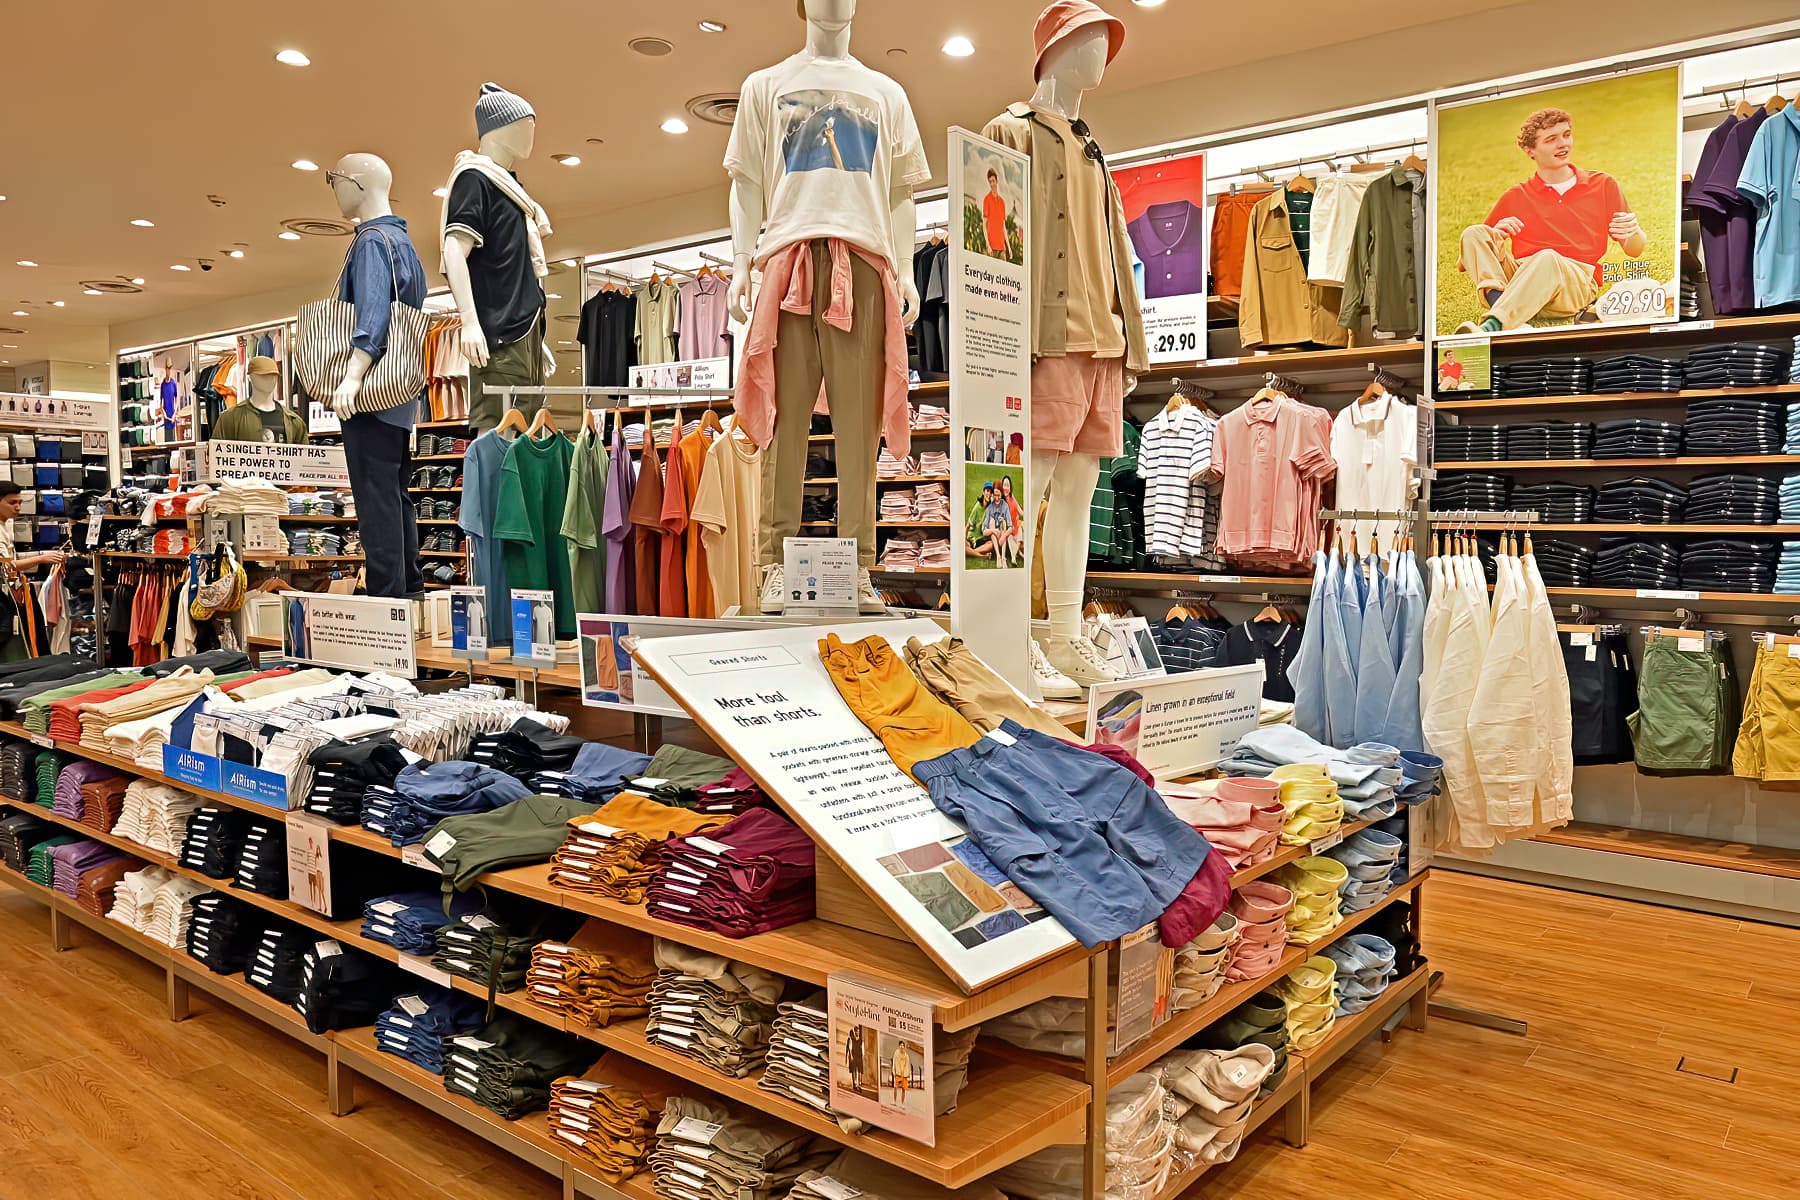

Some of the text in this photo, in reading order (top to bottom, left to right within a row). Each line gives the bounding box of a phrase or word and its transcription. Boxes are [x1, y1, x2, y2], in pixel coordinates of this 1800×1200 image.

[964, 264, 994, 284] Everyday
[1602, 260, 1650, 272] Dry Pique
[1602, 270, 1650, 282] Polo Shirt
[964, 284, 982, 296] made
[984, 288, 998, 300] even
[1154, 332, 1196, 352] $29.90
[216, 444, 326, 458] A SINGLE T-SHIRT HAS
[216, 457, 290, 469] THE POWER TO
[709, 657, 739, 666] Geared
[714, 690, 790, 710] More tool
[1146, 689, 1236, 714] Linen grown in an exceptional field
[732, 706, 822, 728] than shorts.
[178, 753, 205, 772] AIRism
[230, 772, 256, 790] AIRism
[844, 1000, 880, 1022] StyleHint
